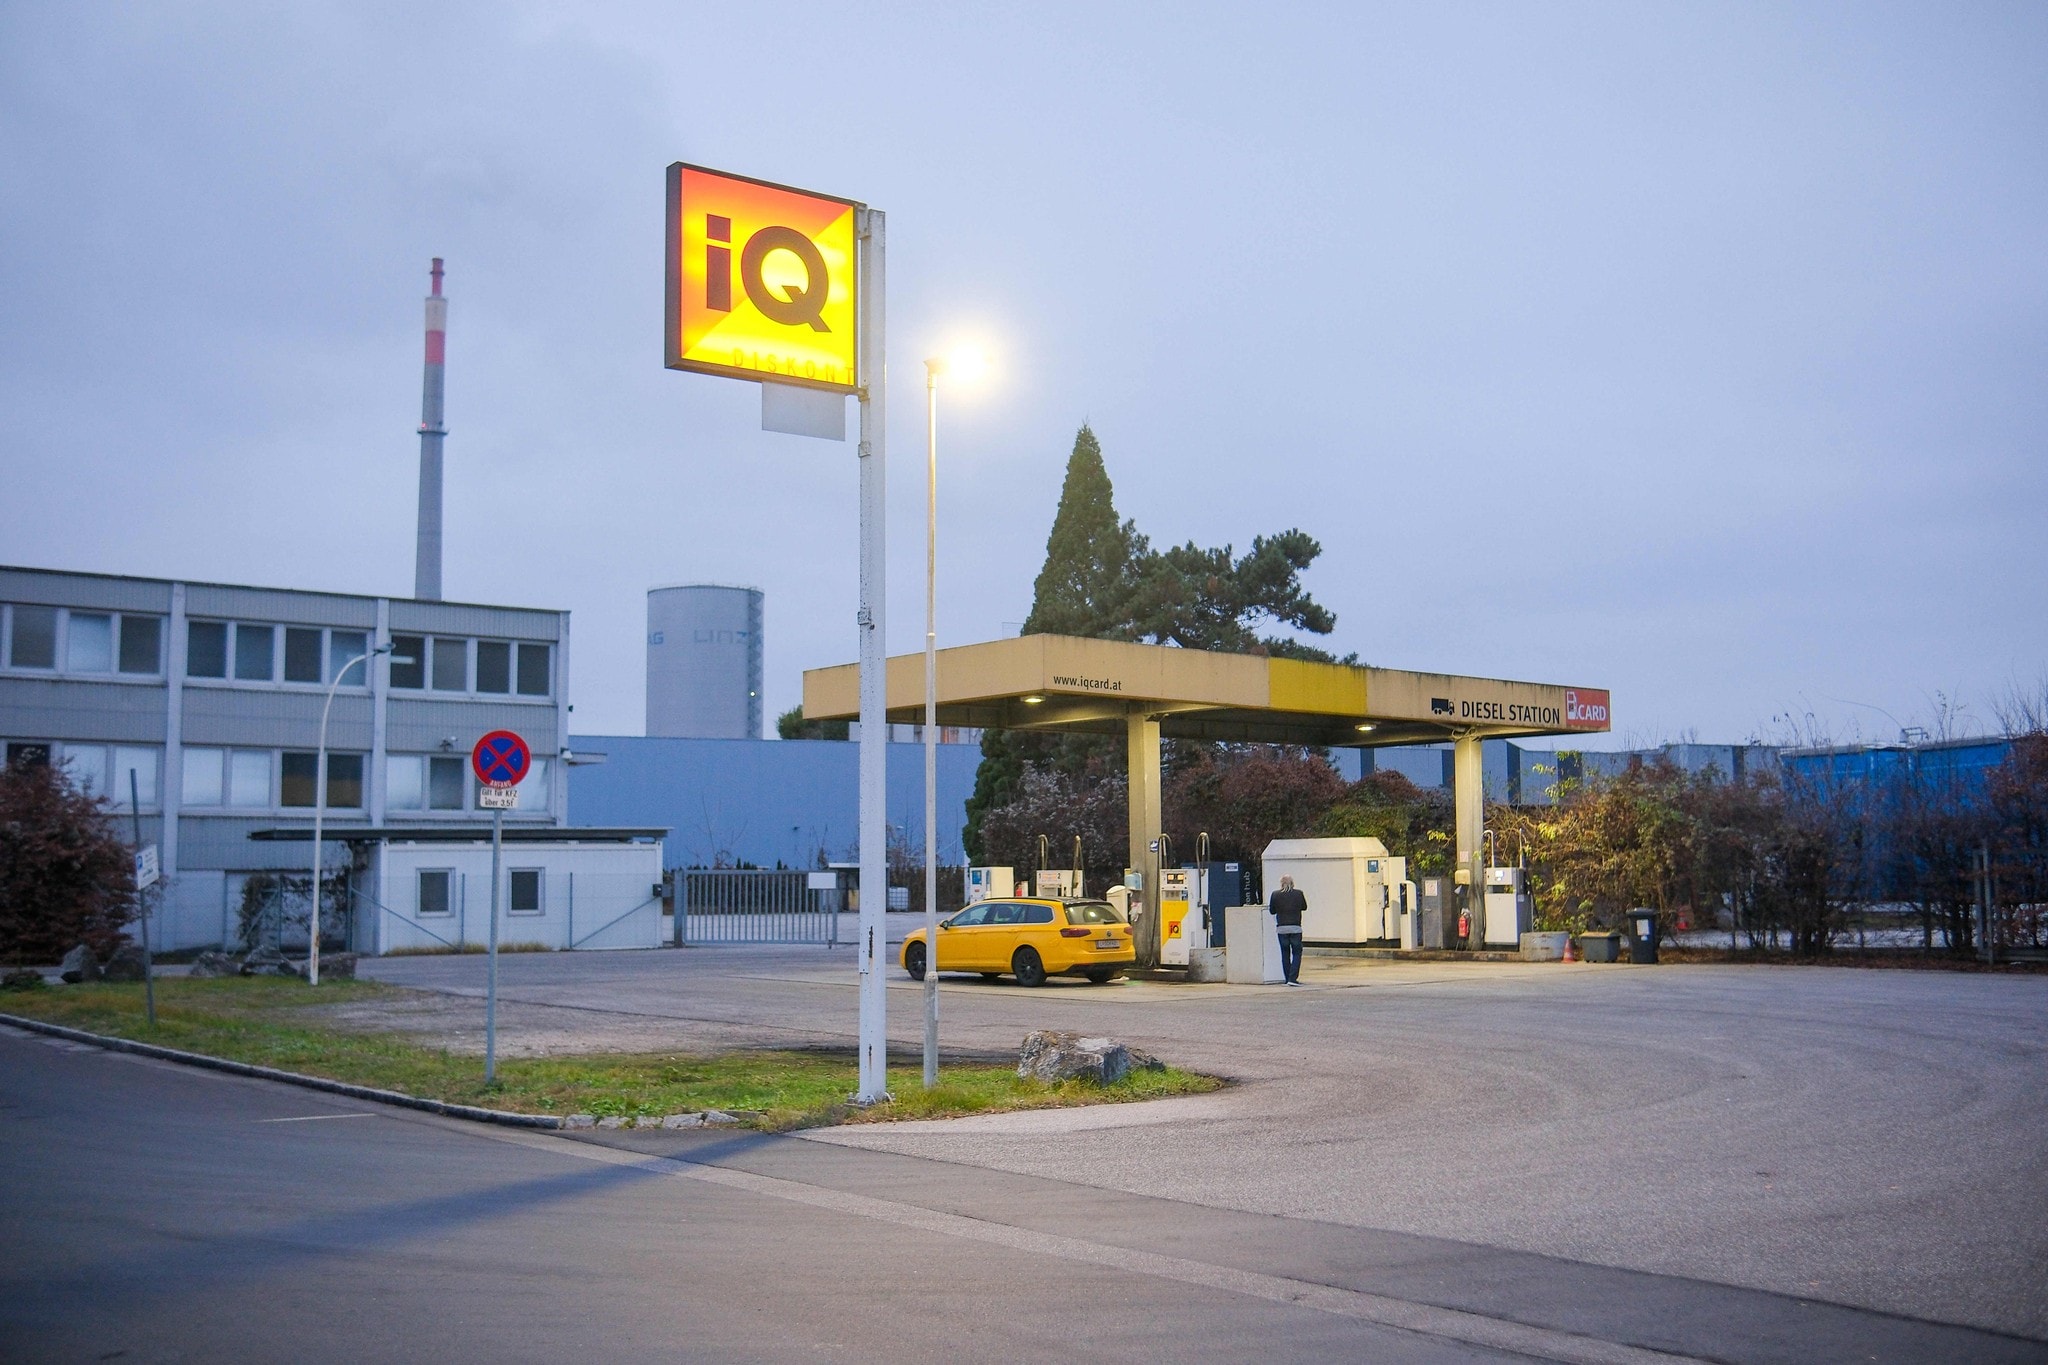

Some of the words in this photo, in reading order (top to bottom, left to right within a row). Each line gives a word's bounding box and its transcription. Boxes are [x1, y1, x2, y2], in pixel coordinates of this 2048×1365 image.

[706, 213, 832, 333] iQ
[1053, 675, 1122, 691] www.iqcard.at
[1461, 701, 1506, 721] DIESEL
[1508, 703, 1560, 725] STATION
